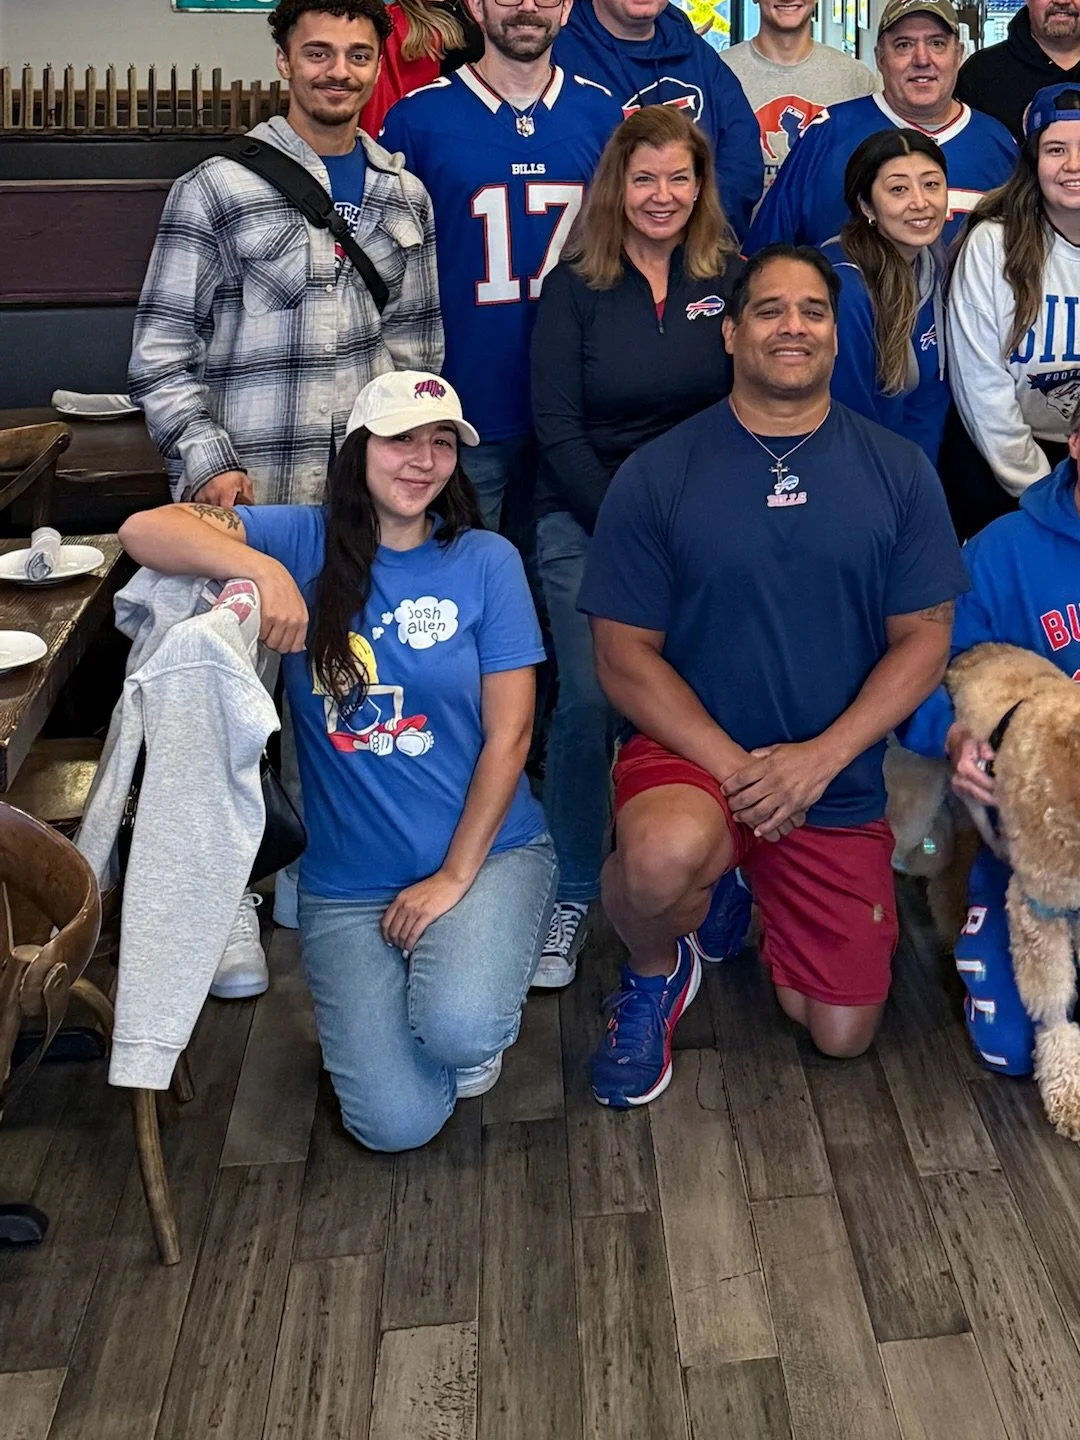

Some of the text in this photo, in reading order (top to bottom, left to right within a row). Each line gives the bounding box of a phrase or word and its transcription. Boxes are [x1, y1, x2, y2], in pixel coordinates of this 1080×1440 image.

[511, 162, 546, 175] BILLS
[471, 180, 585, 306] 17
[408, 606, 441, 620] josh
[407, 620, 446, 635] allen
